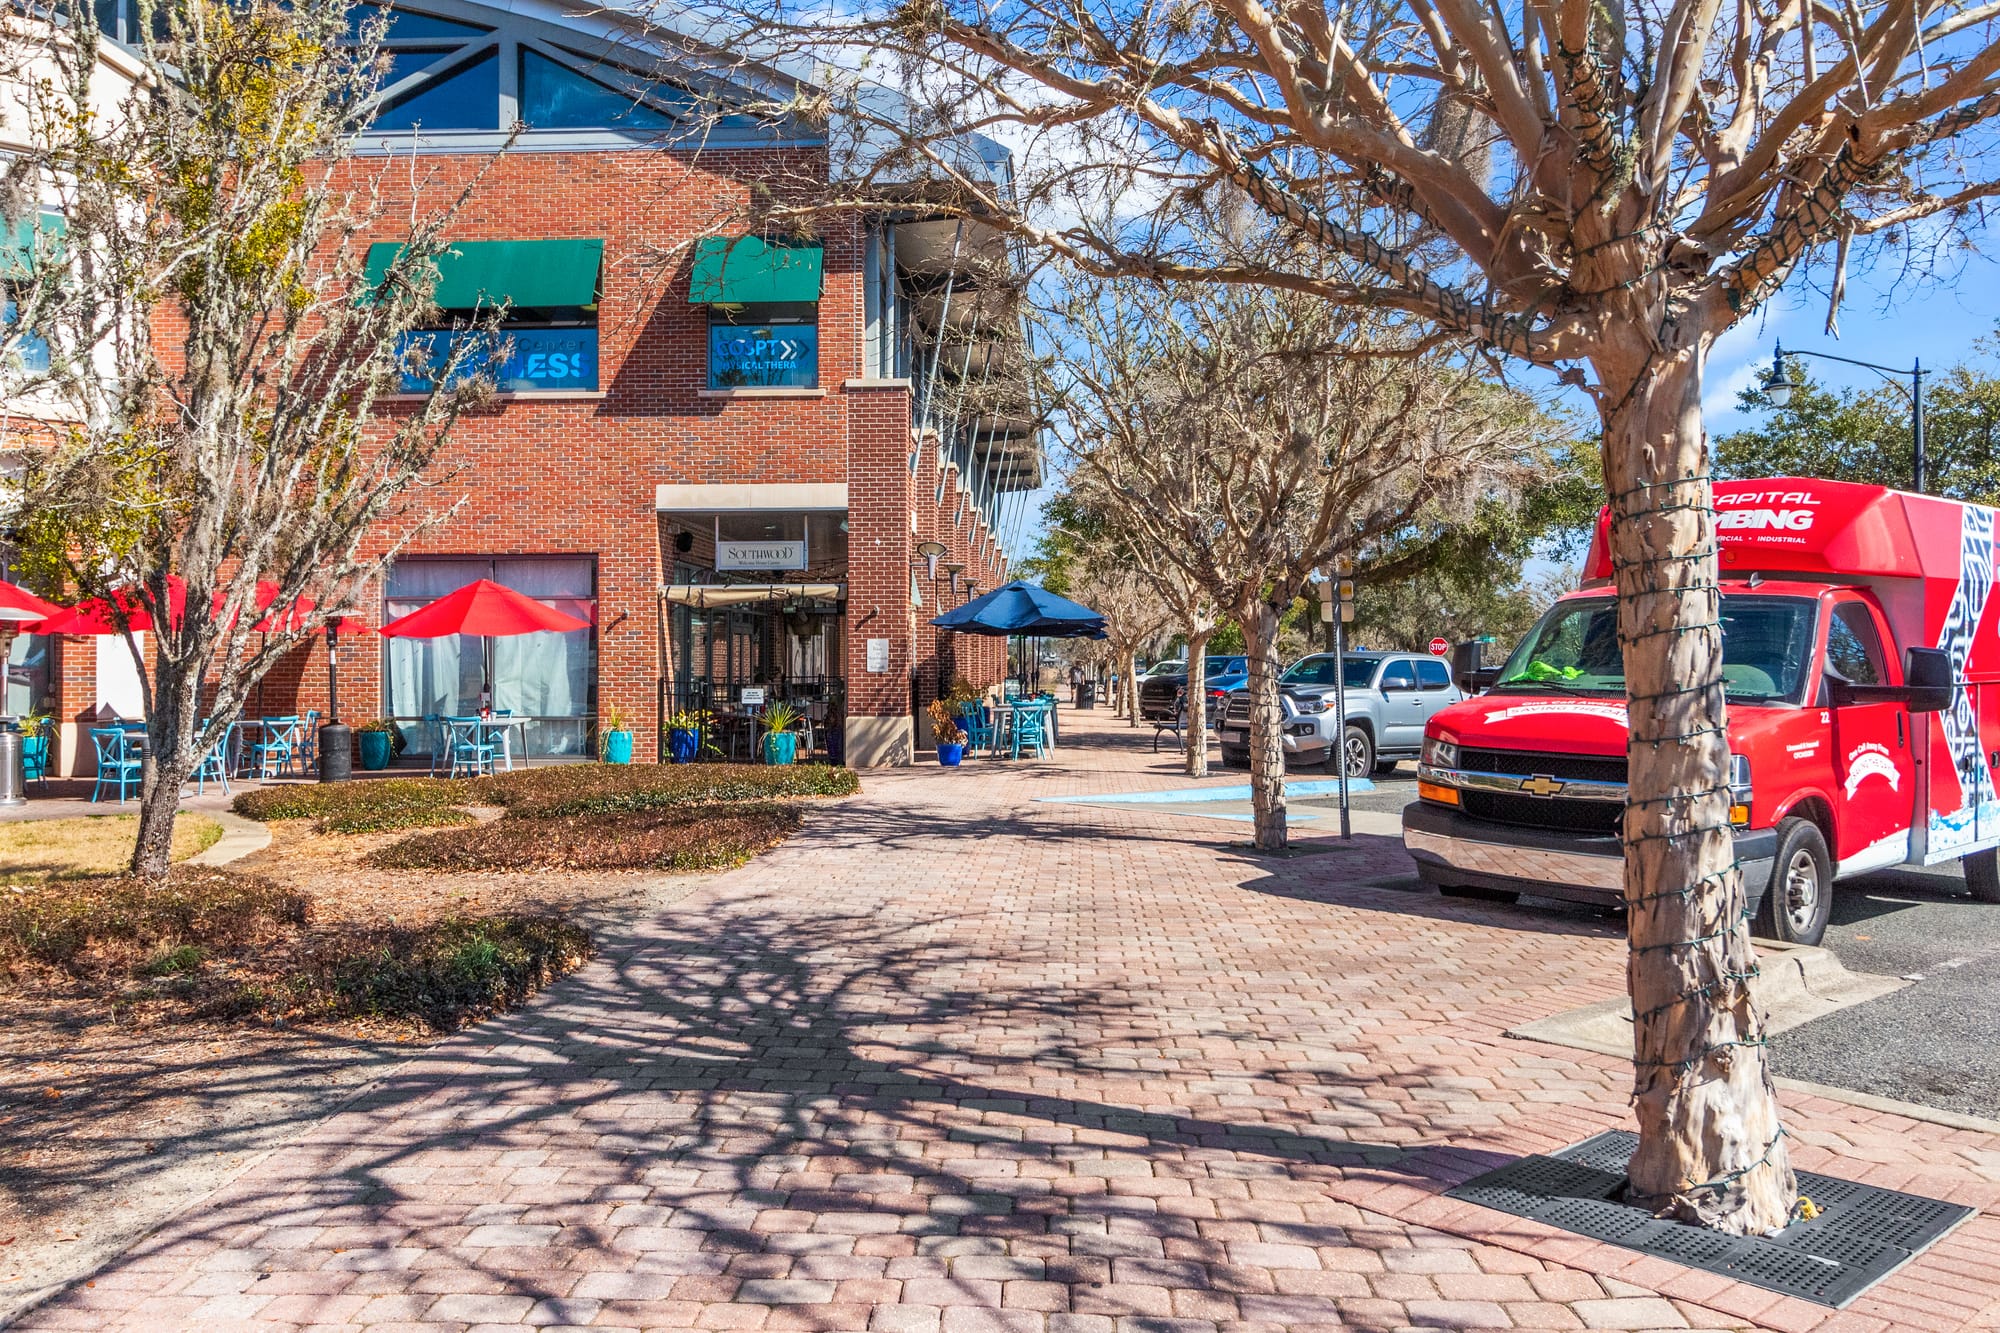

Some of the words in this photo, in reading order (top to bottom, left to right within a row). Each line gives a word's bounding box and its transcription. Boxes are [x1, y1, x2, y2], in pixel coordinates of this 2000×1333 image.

[518, 338, 586, 353] Center
[717, 340, 779, 356] COSPT
[503, 353, 590, 378] NESS
[765, 361, 796, 369] THERA
[1712, 509, 1814, 530] MBING
[1757, 535, 1807, 544] INDUSTRIAL
[1431, 643, 1447, 651] STOP
[1511, 705, 1567, 714] SAVING
[1820, 711, 1831, 724] 22
